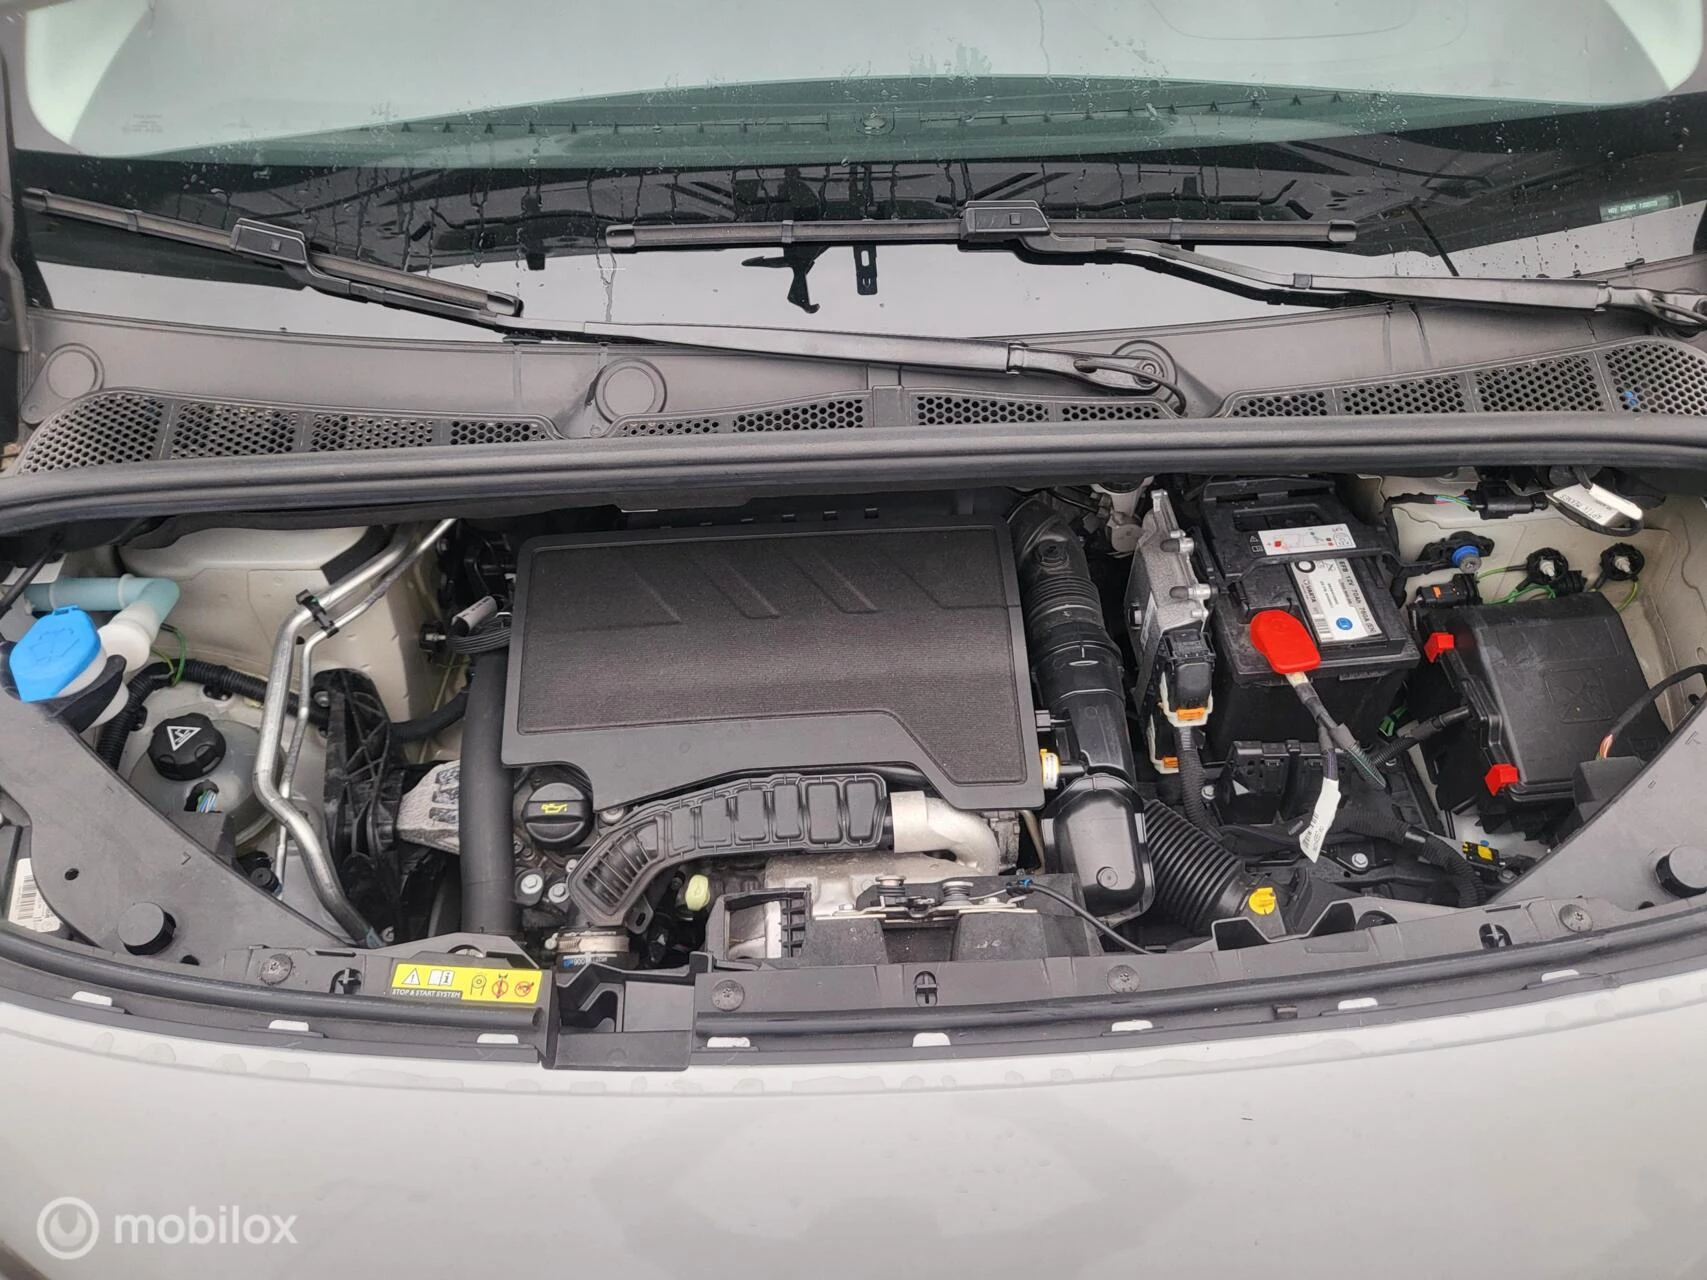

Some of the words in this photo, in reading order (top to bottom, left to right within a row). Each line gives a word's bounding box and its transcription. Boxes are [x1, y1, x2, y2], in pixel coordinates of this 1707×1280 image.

[1339, 561, 1348, 573] EFB
[1306, 584, 1317, 603] VARTA
[415, 990, 435, 998] START
[436, 991, 461, 999] SYSTEM
